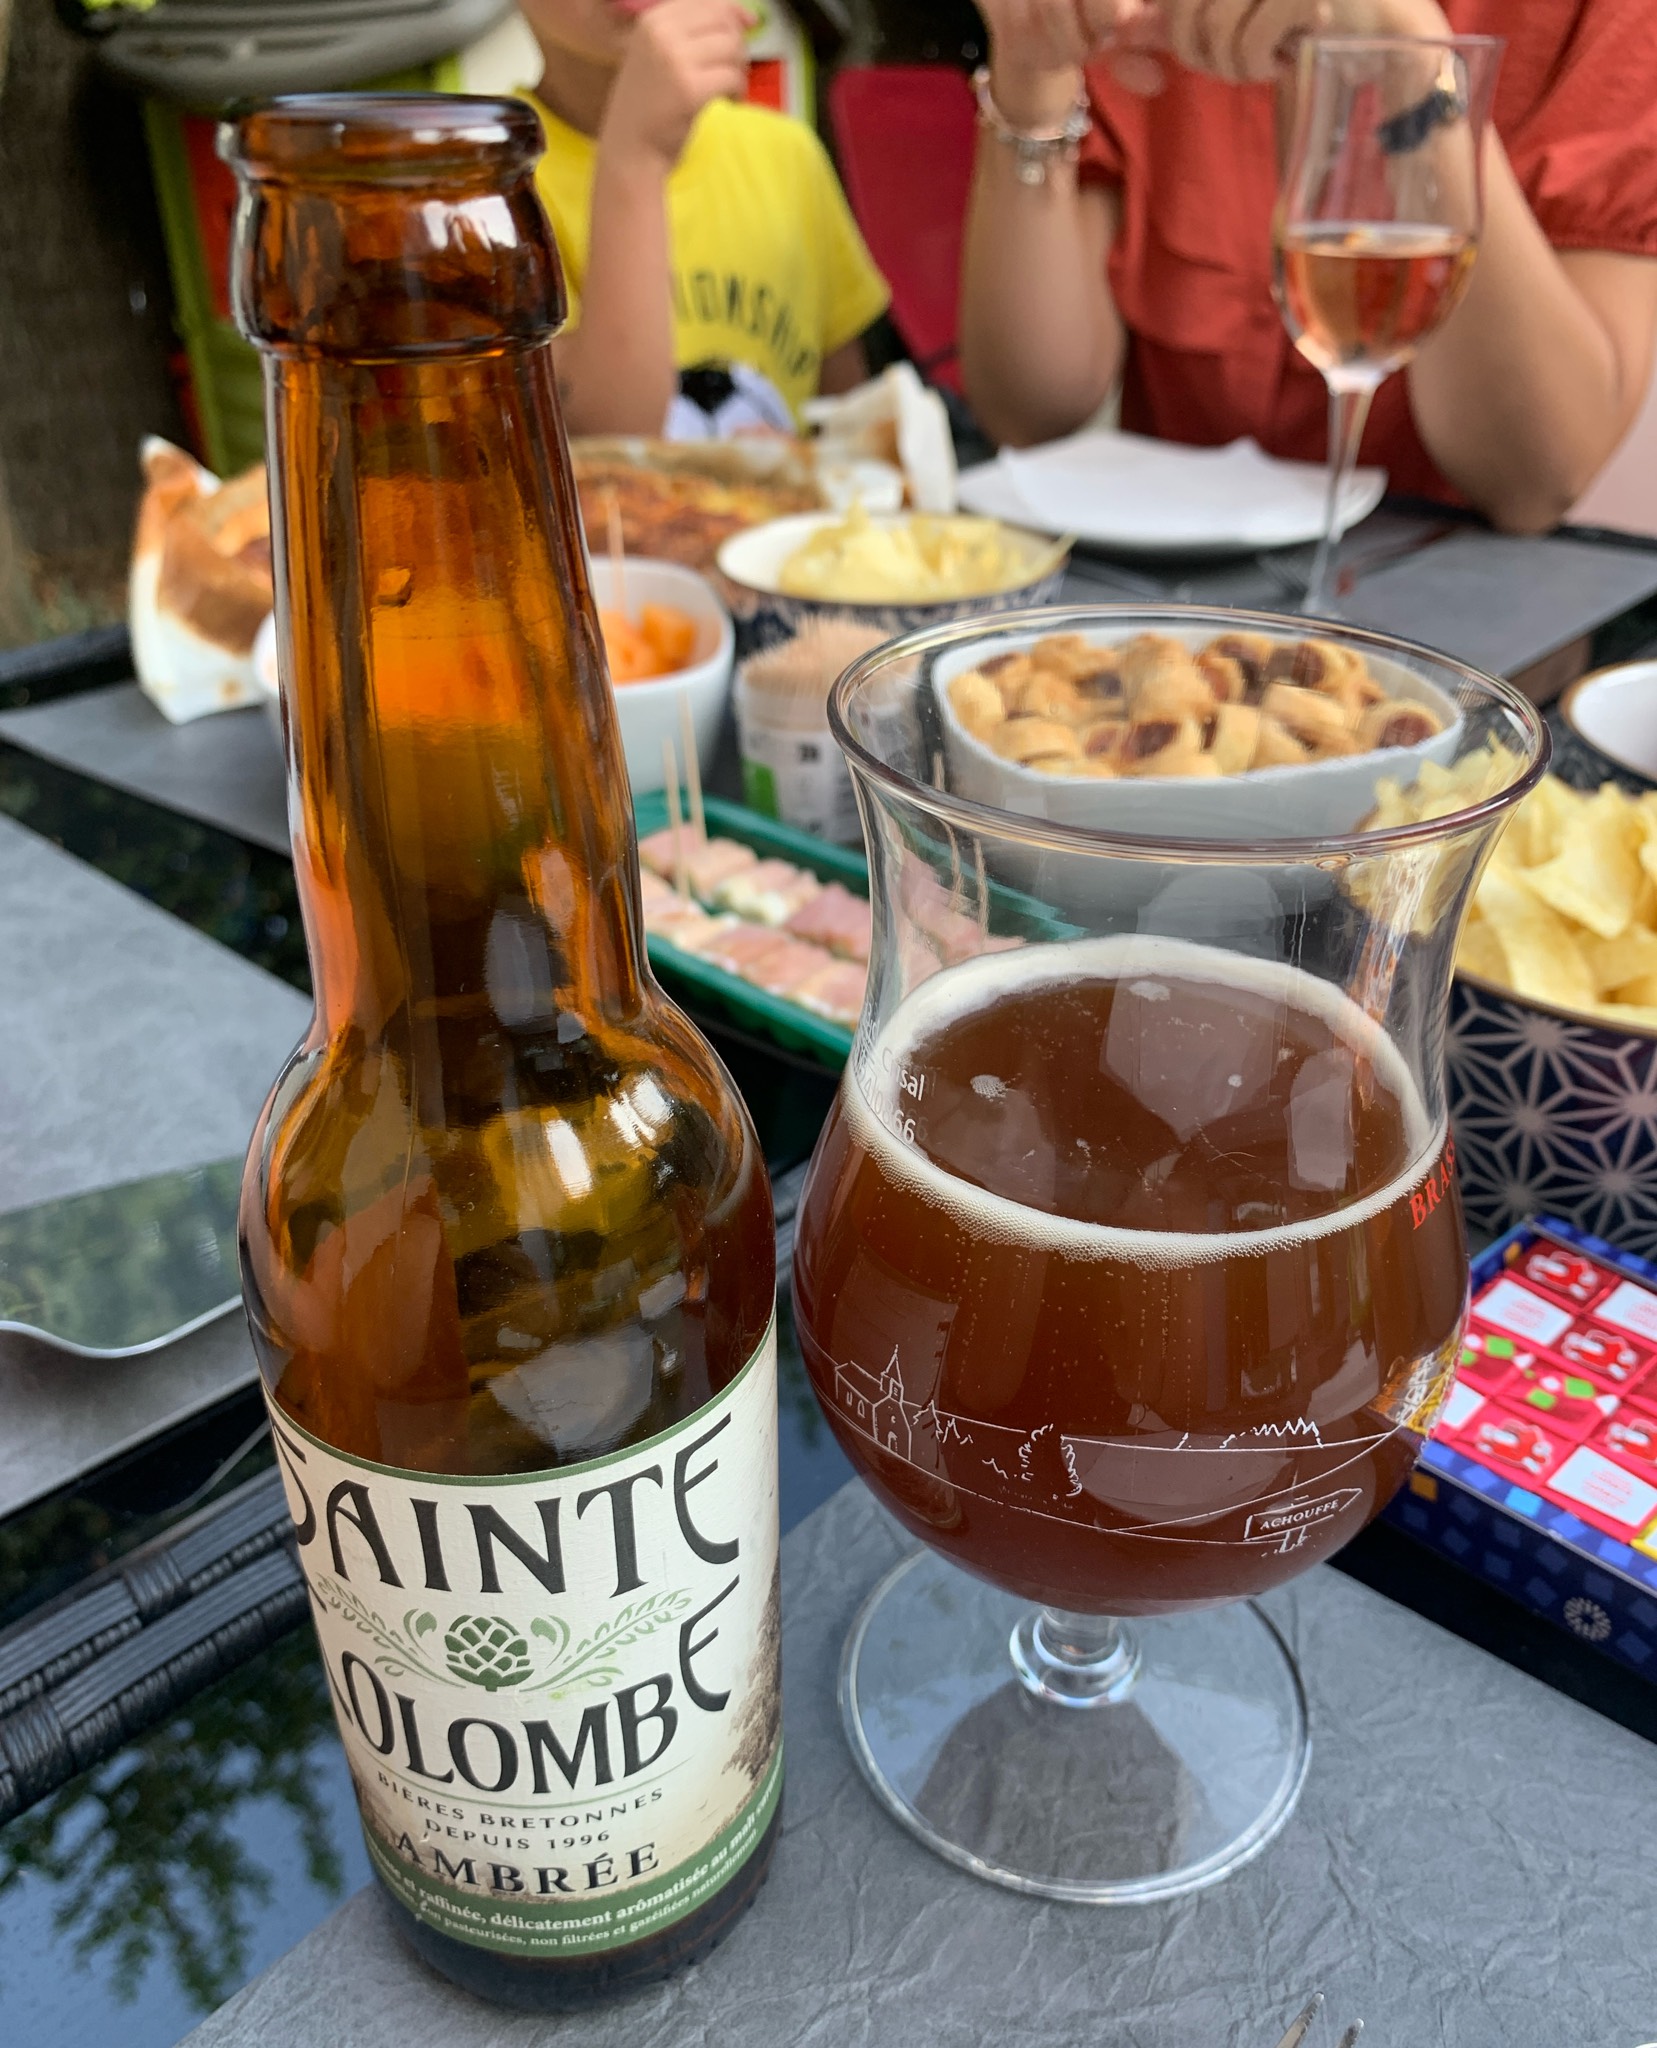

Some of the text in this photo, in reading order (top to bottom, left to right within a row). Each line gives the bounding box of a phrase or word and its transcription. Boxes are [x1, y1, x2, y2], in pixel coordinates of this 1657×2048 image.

[270, 1411, 740, 1599] SAINTE
[1260, 1499, 1339, 1530] ACHOUFFE
[377, 1770, 663, 1830] BIÈRES BRETONNES
[397, 1831, 660, 1895] AMBRÉE
[425, 1818, 531, 1850] DEPUIS
[546, 1830, 611, 1850] 1996
[490, 1910, 613, 1932] délicatement
[616, 1861, 709, 1920] arômatisée
[711, 1846, 728, 1868] au
[530, 1935, 558, 1946] non
[562, 1930, 610, 1946] filtrées
[613, 1925, 626, 1936] et
